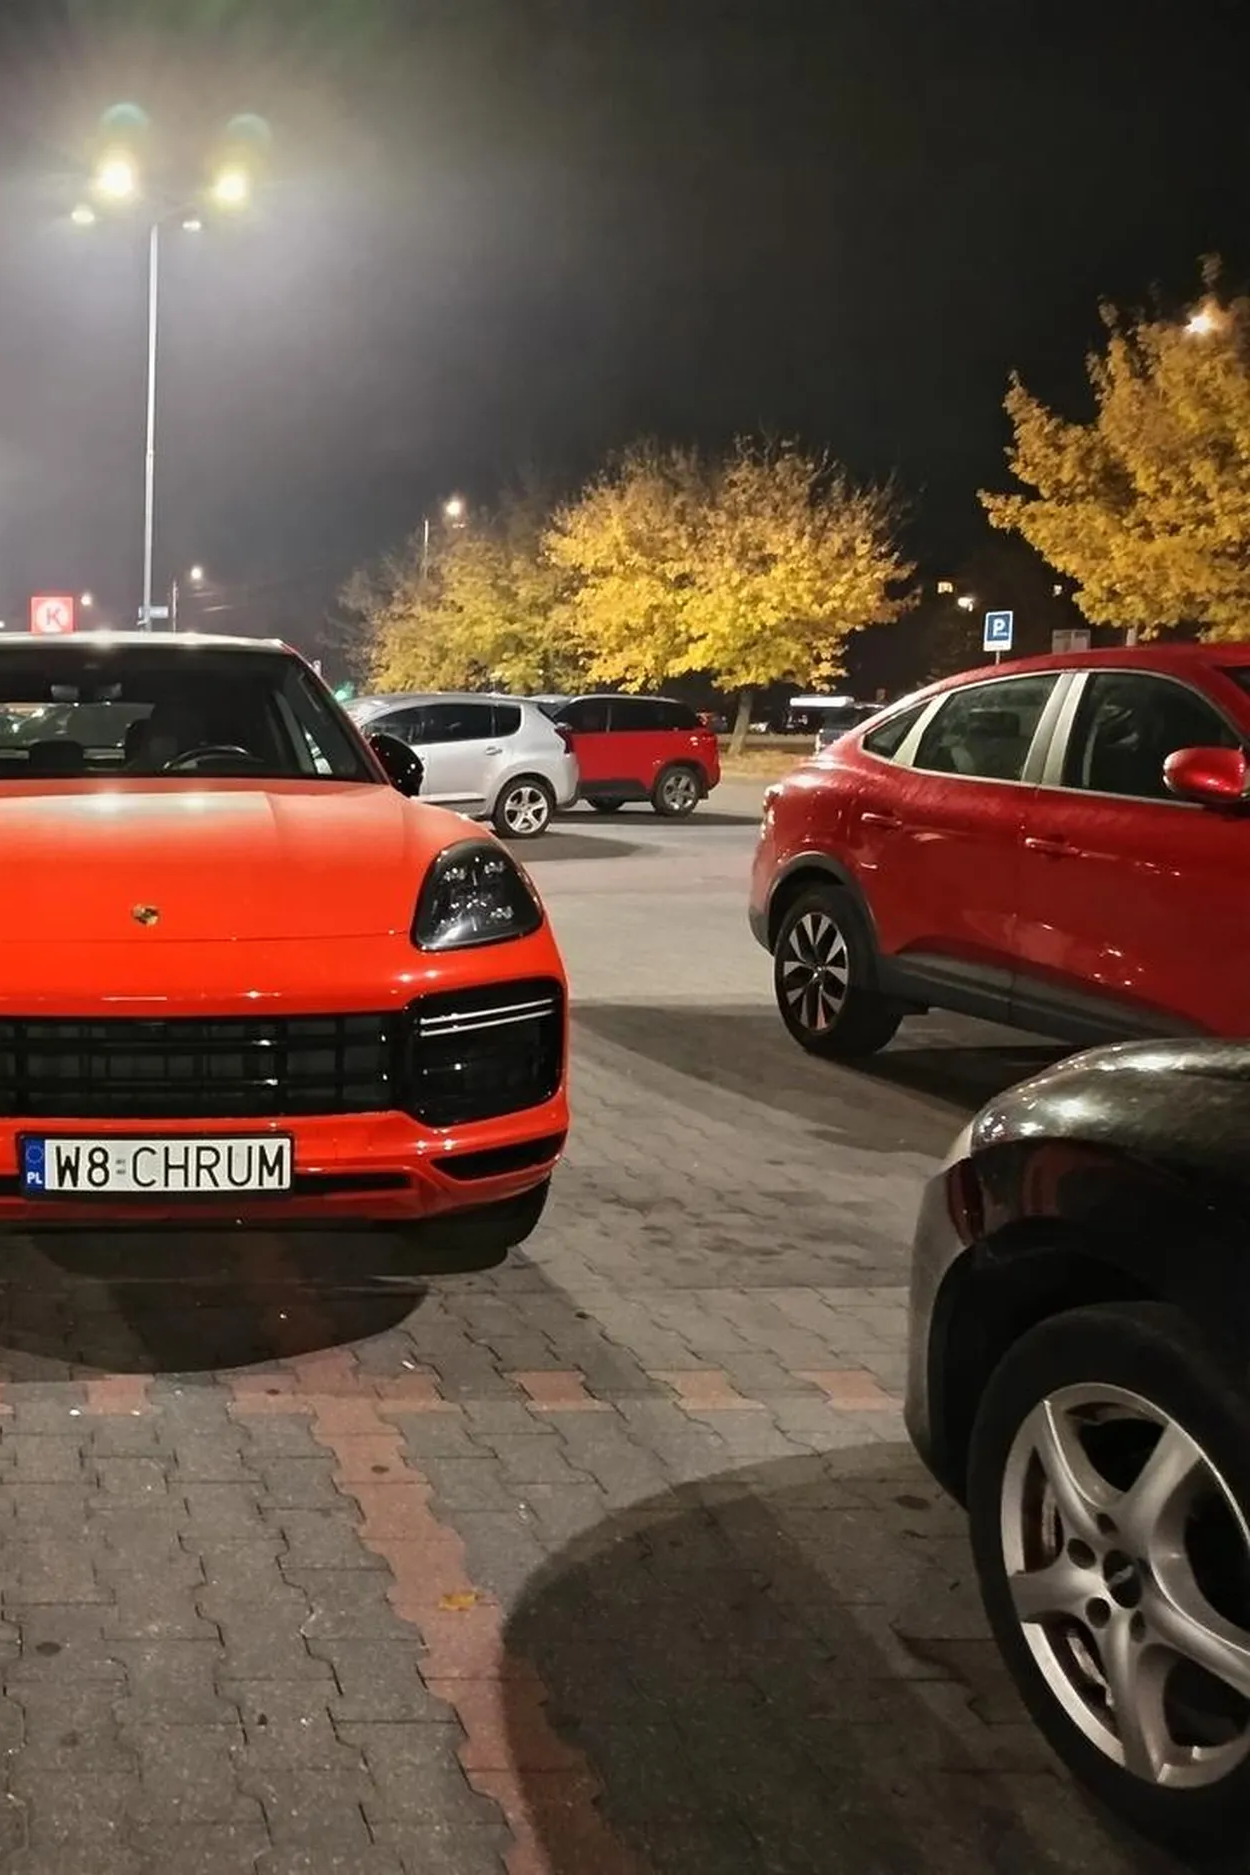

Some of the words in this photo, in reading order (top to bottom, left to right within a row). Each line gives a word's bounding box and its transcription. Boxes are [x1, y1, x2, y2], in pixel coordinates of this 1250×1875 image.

[46, 607, 64, 629] K
[993, 618, 1005, 637] P
[55, 1145, 110, 1189] W8
[132, 1144, 285, 1188] CHRUM
[27, 1171, 43, 1184] PL
